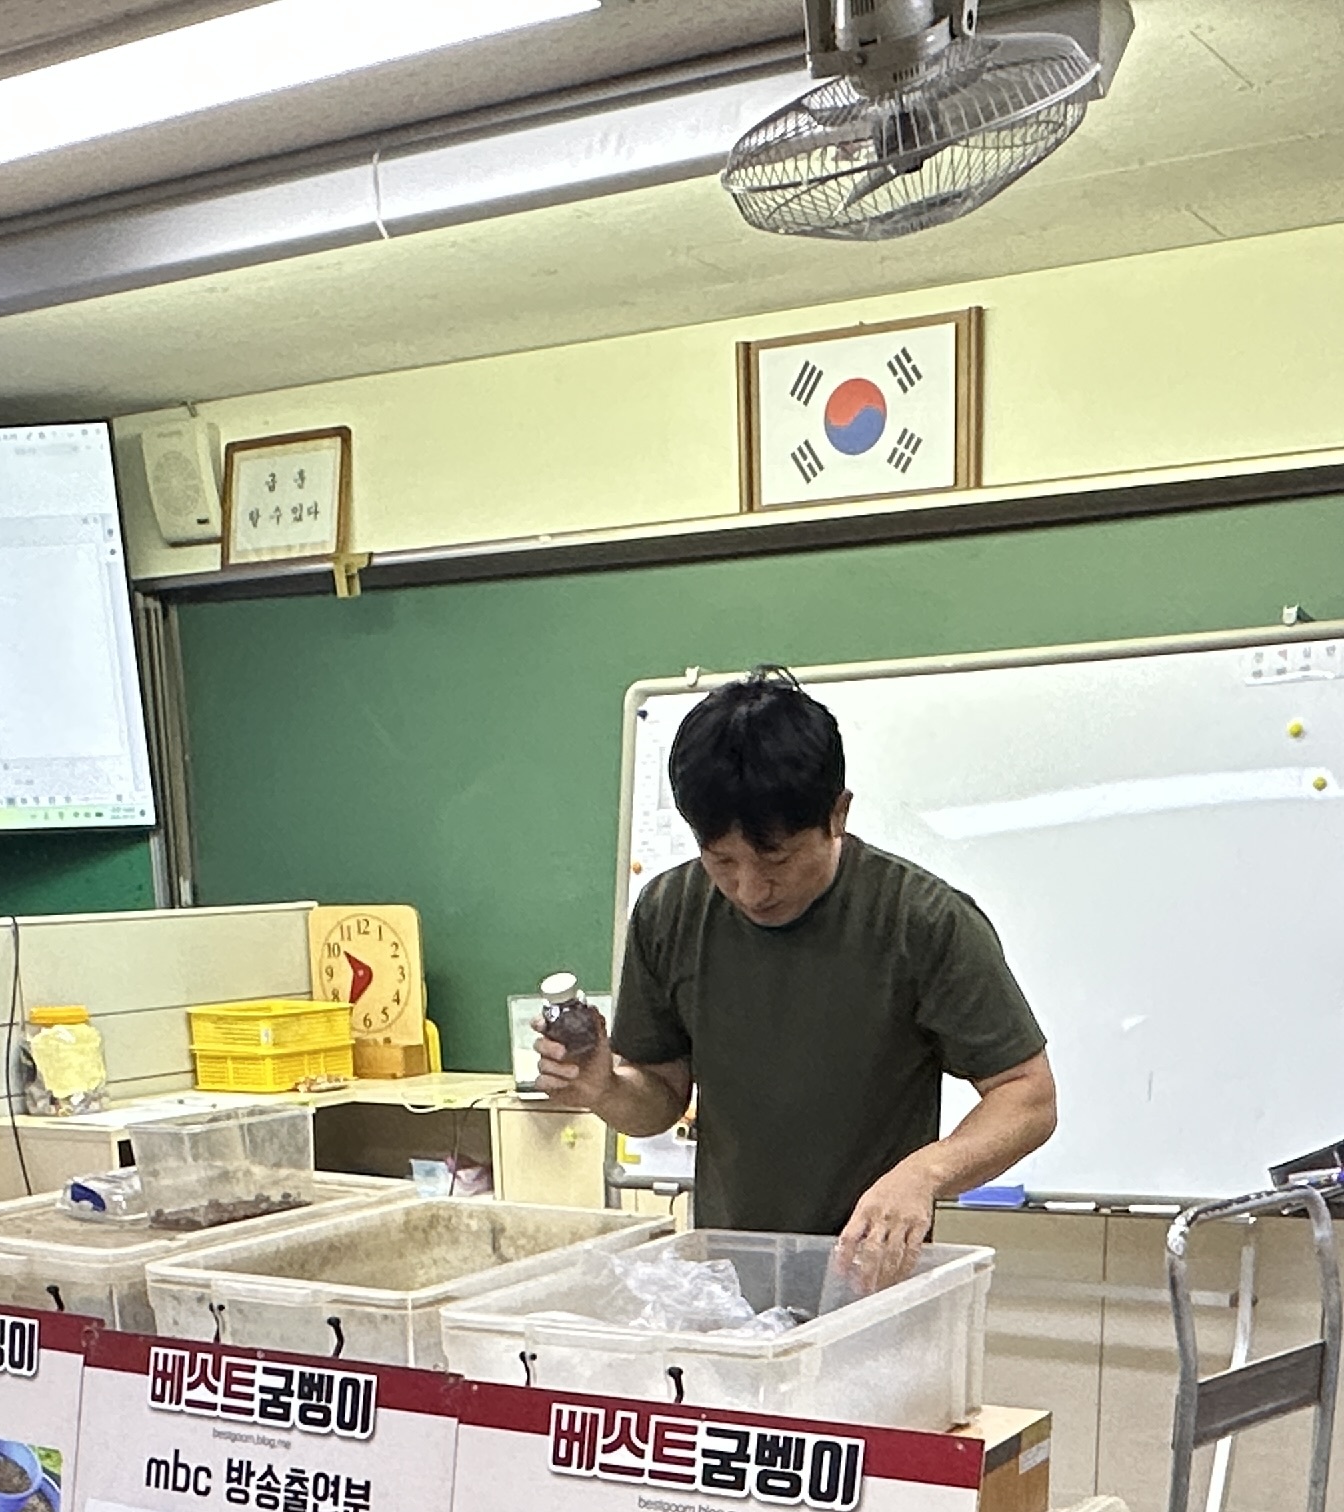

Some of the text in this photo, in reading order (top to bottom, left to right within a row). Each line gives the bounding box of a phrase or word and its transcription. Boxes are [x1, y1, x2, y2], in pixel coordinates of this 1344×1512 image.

[340, 924, 352, 941] 11
[357, 919, 370, 935] 12
[326, 942, 341, 958] 10
[391, 941, 399, 958] 2
[325, 965, 334, 981] 9
[397, 965, 406, 983] 3
[331, 989, 340, 1002] 8
[392, 989, 400, 1005] 4
[363, 1012, 372, 1029] 6
[381, 1007, 389, 1022] 5
[149, 1347, 376, 1440] 베스트굼벵이
[550, 1404, 864, 1511] 베스트굼벵이
[145, 1448, 212, 1497] mbc
